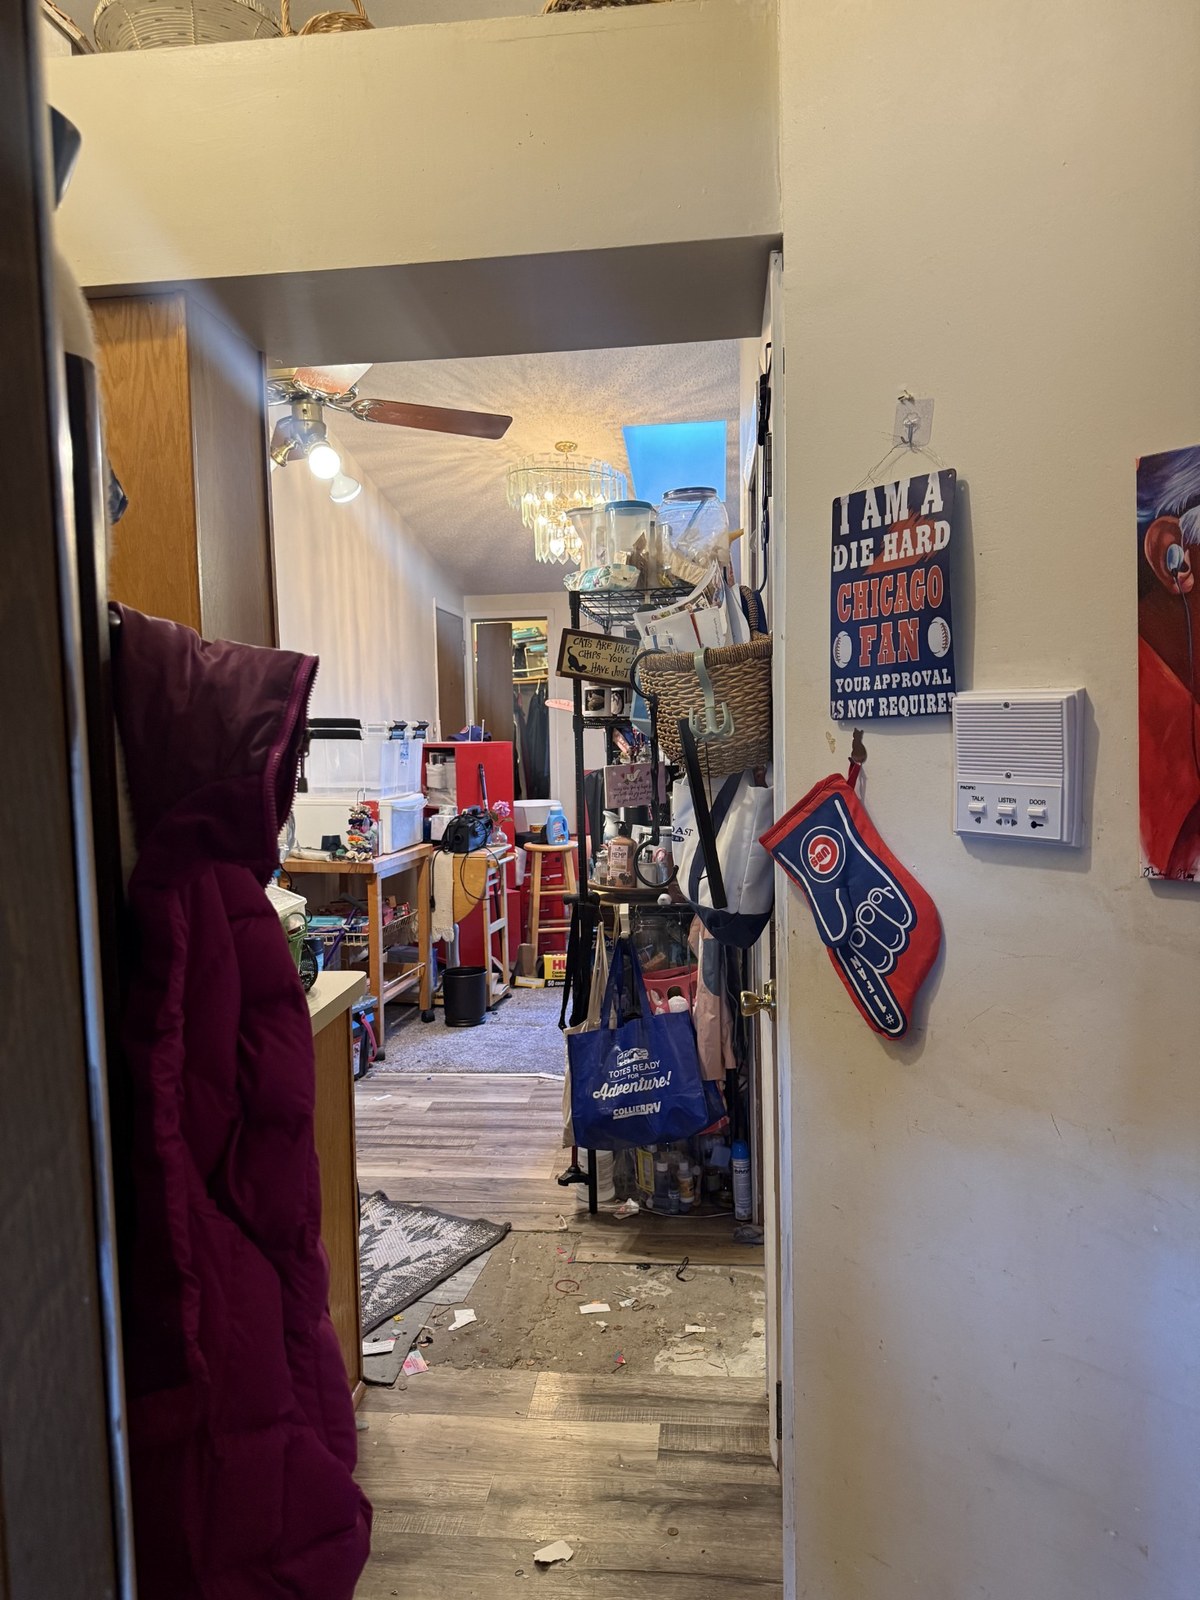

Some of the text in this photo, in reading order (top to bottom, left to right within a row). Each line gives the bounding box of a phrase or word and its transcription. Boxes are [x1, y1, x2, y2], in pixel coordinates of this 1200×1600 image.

[840, 471, 944, 536] I AM A
[833, 520, 951, 572] DIE HARD
[837, 564, 944, 623] CHICAGO
[573, 638, 592, 648] CATS
[596, 641, 612, 651] ARE
[614, 642, 630, 654] LIKE
[859, 617, 920, 668] FAN
[590, 662, 610, 674] HAVE
[835, 668, 951, 693] YOUR APPROVAL
[831, 700, 844, 719] IS
[847, 698, 874, 718] NOT
[850, 956, 875, 994] FAN
[608, 1060, 660, 1078] TOTES READY
[628, 1072, 640, 1080] FOR
[592, 1070, 672, 1100] Adventure!
